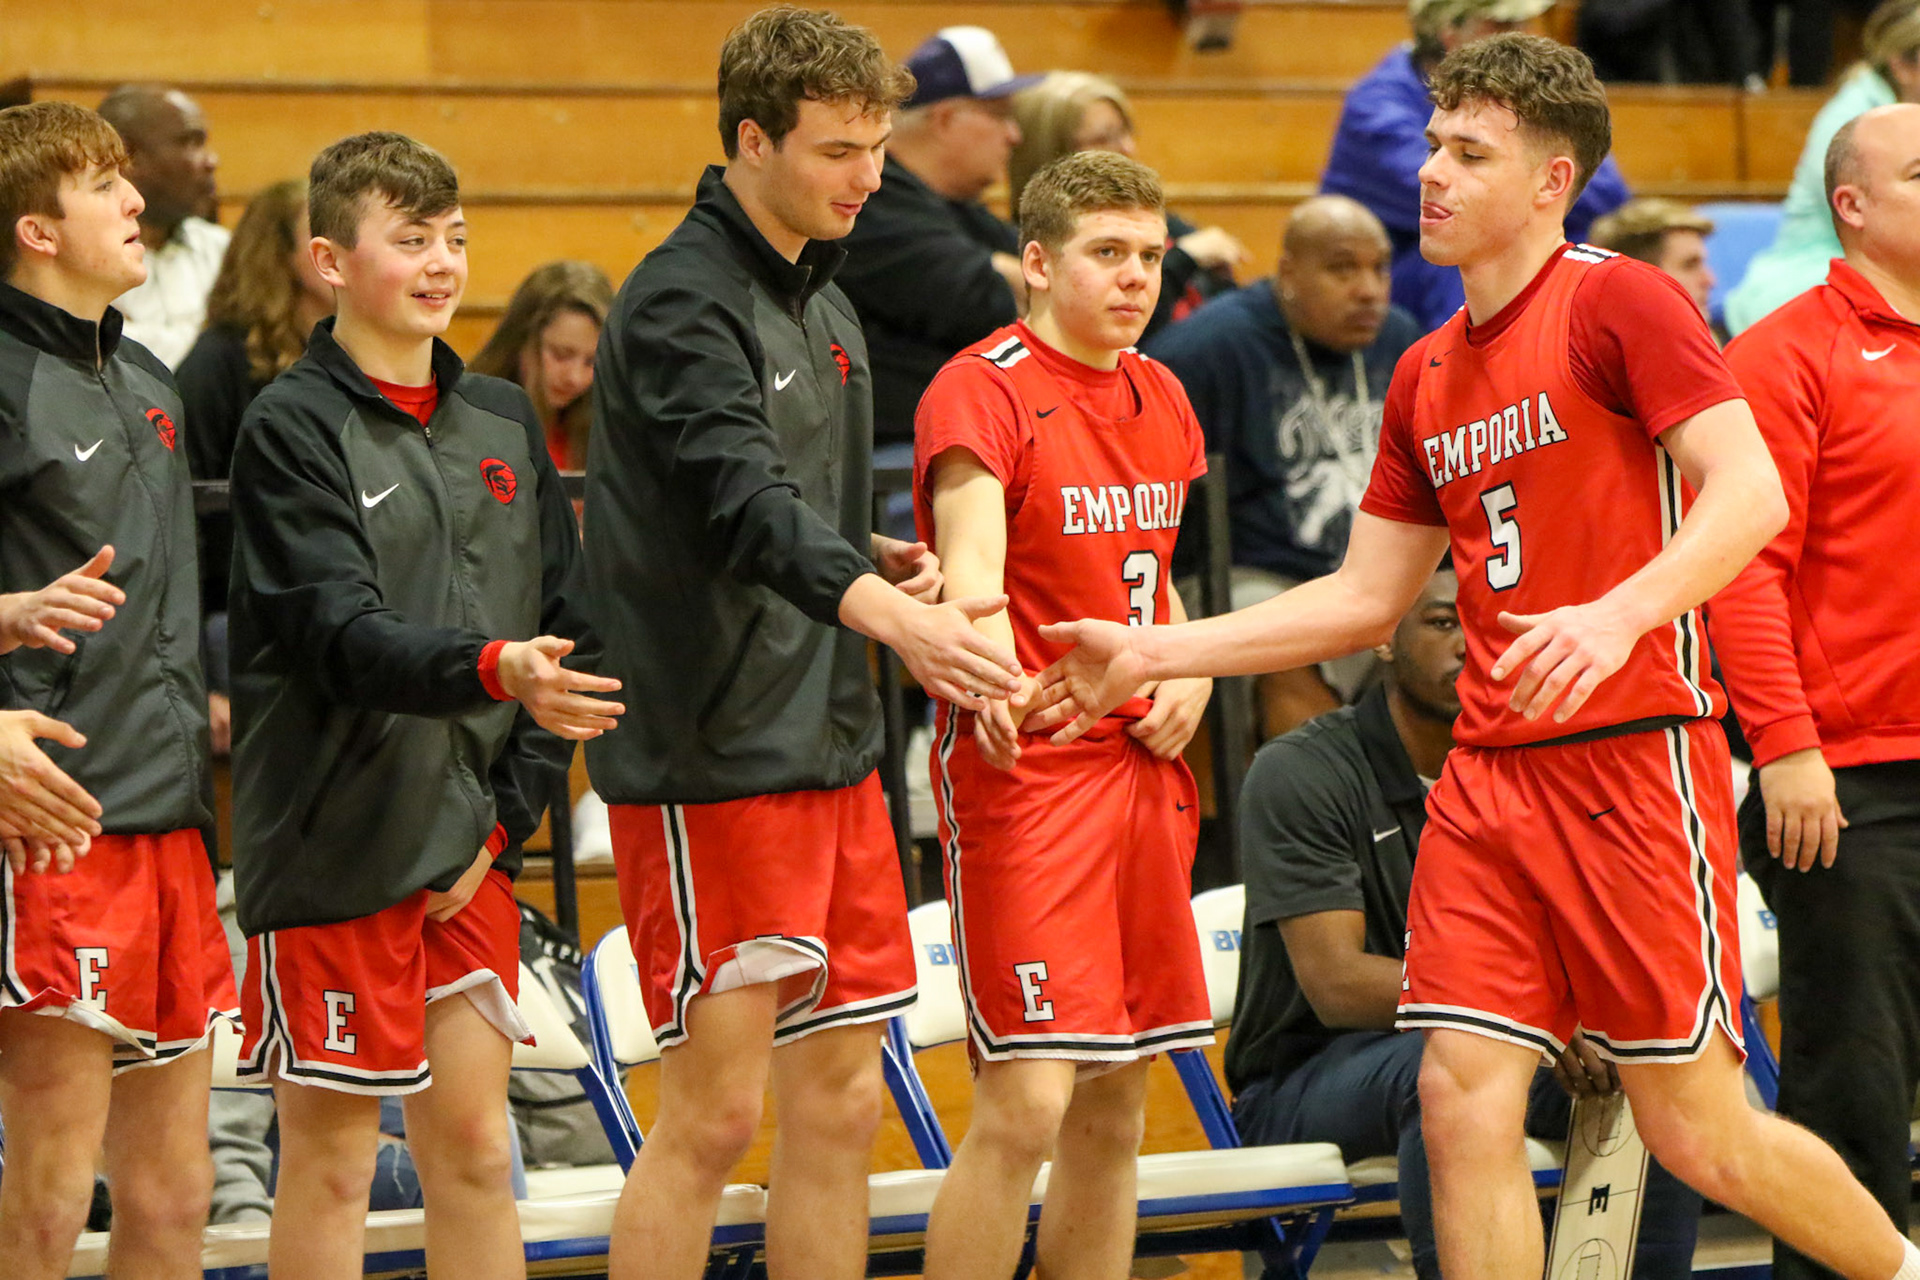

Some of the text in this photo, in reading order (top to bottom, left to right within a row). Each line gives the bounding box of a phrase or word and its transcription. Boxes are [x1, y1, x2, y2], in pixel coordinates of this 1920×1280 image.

[1422, 391, 1569, 490] EMPORIA
[1479, 480, 1523, 593] 5
[1122, 549, 1160, 627] 3
[74, 946, 109, 1012] E
[1013, 960, 1056, 1023] E
[323, 989, 357, 1056] E
[1587, 1183, 1611, 1216] E
